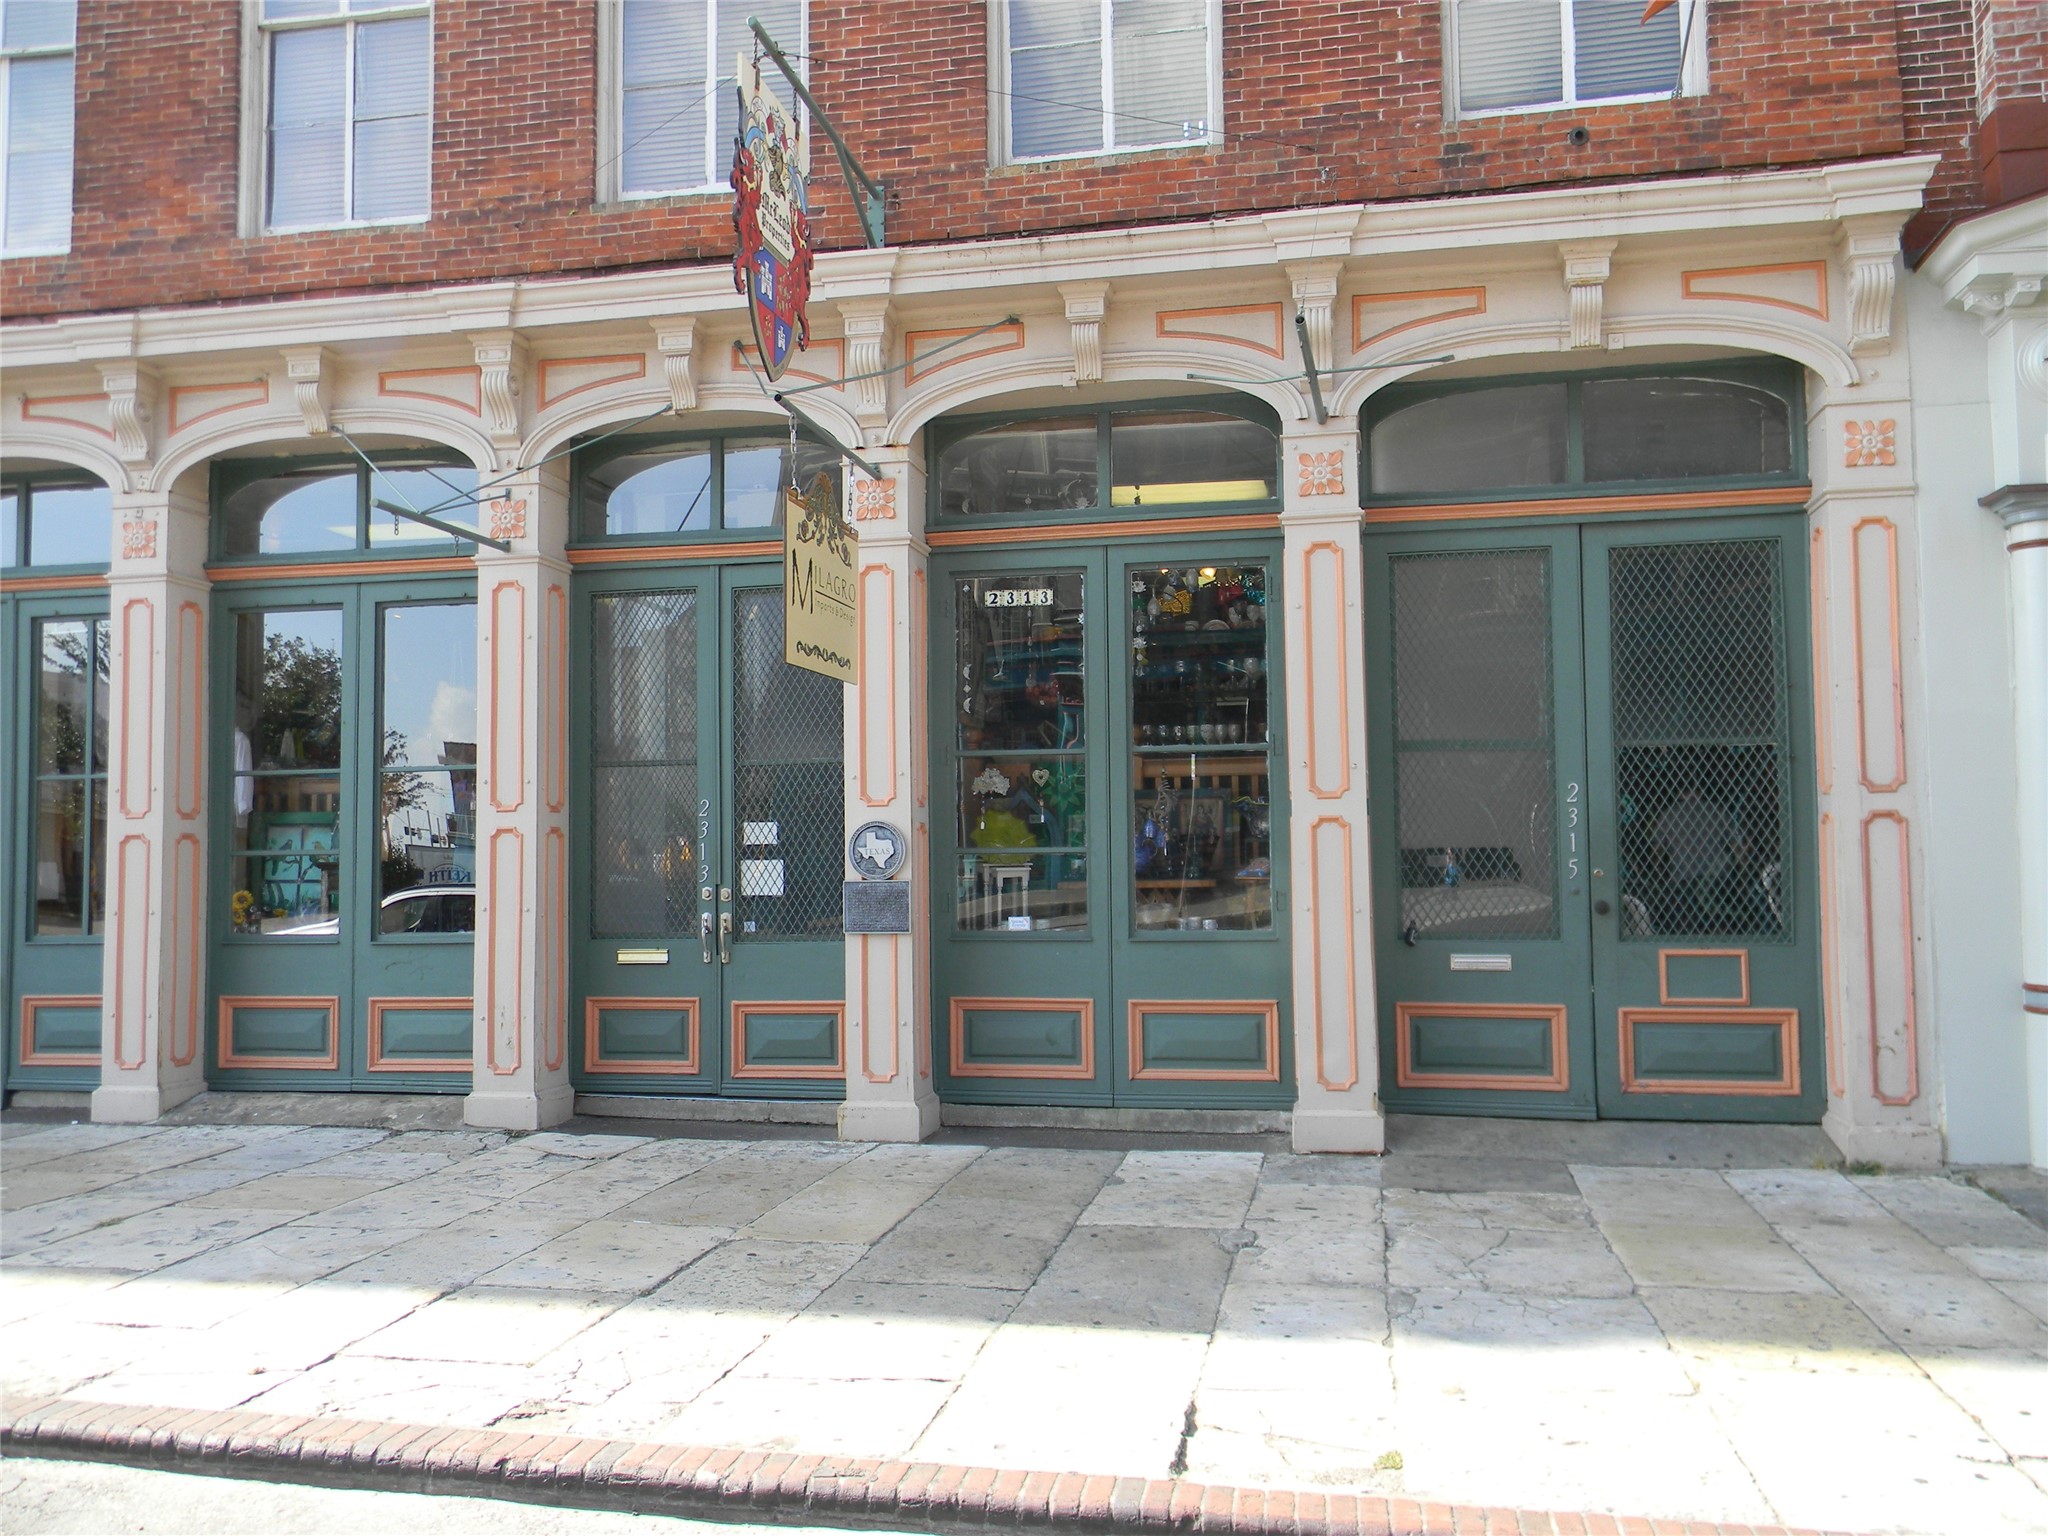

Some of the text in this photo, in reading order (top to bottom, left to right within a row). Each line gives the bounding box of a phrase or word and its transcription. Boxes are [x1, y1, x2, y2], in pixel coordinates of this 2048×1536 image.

[762, 210, 790, 251] Properties
[989, 591, 1048, 605] 2313
[698, 799, 710, 883] 2313
[1566, 782, 1579, 880] 2315
[864, 848, 891, 857] TEXAS
